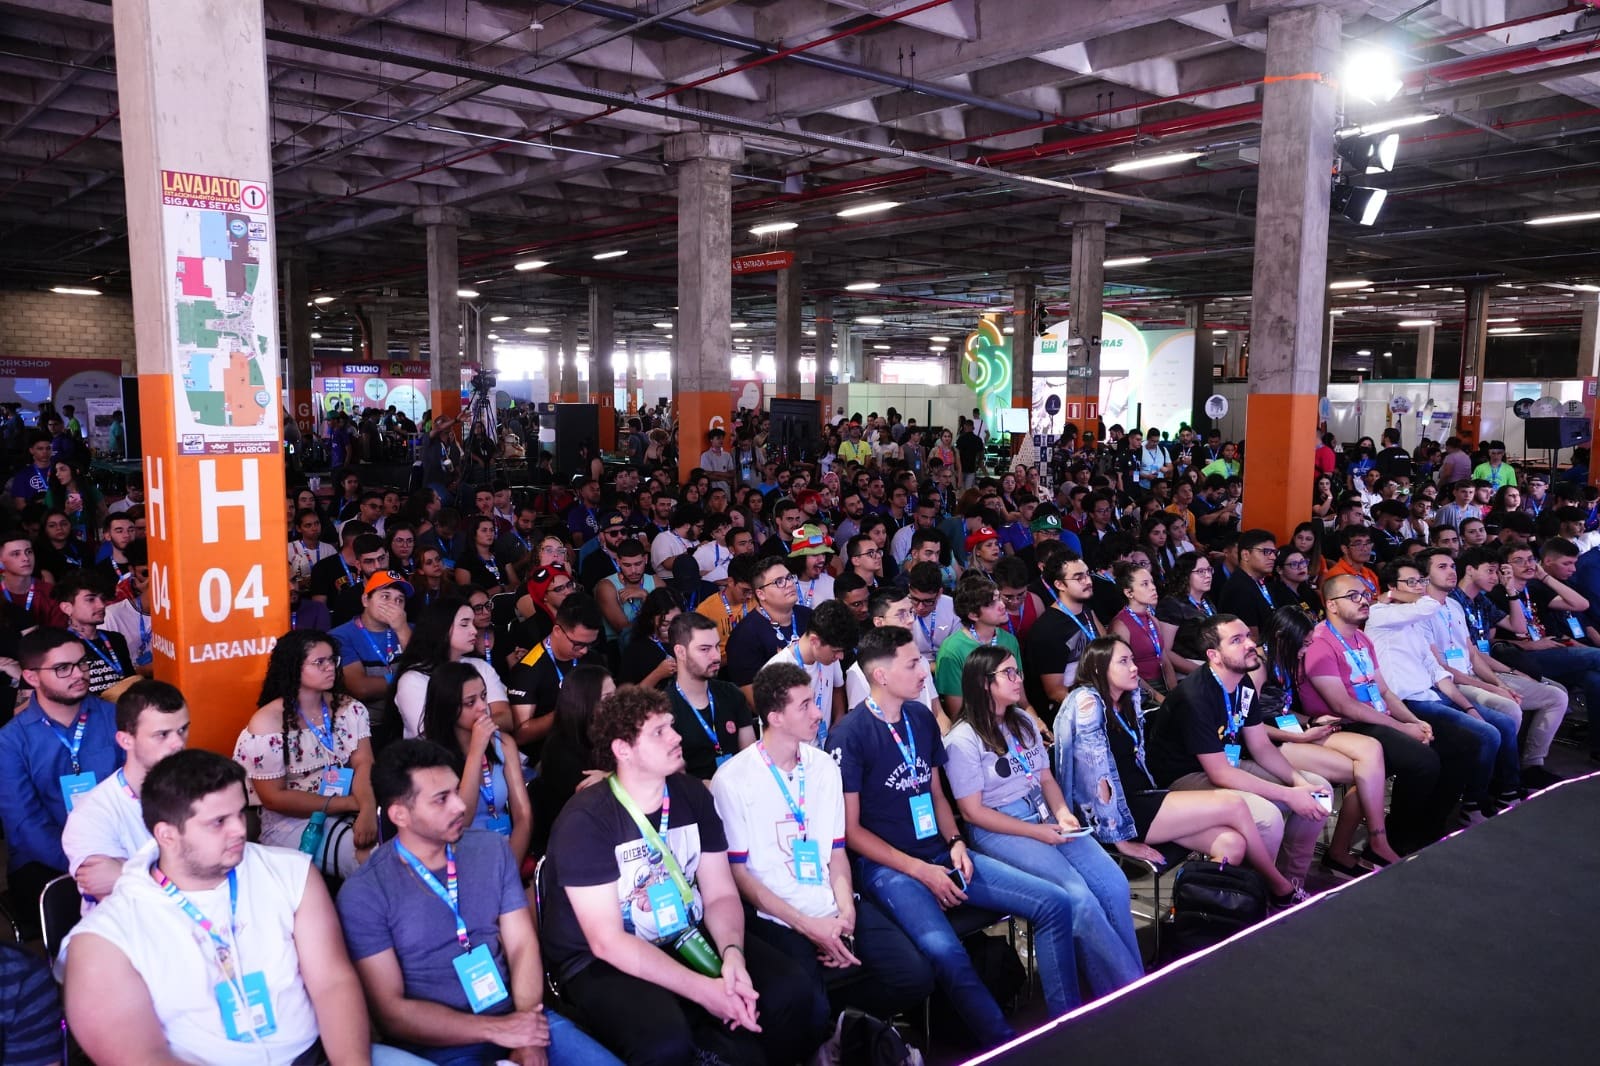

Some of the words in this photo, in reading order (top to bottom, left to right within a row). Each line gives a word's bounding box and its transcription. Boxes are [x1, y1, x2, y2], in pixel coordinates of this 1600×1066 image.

[162, 172, 240, 198] LAVAJATO
[164, 196, 189, 206] SIGA
[192, 200, 206, 208] AS
[208, 203, 240, 211] SETAS
[345, 365, 379, 373] STUDIO
[298, 403, 309, 416] G
[709, 415, 724, 431] G
[234, 446, 271, 454] MARROM
[147, 455, 166, 541] H
[199, 458, 261, 543] H
[152, 561, 171, 620] 04
[199, 564, 269, 623] 04
[152, 632, 176, 661] LARANJA
[189, 636, 277, 663] LARANJA
[1010, 747, 1039, 765] capus
[1012, 759, 1034, 775] pay
